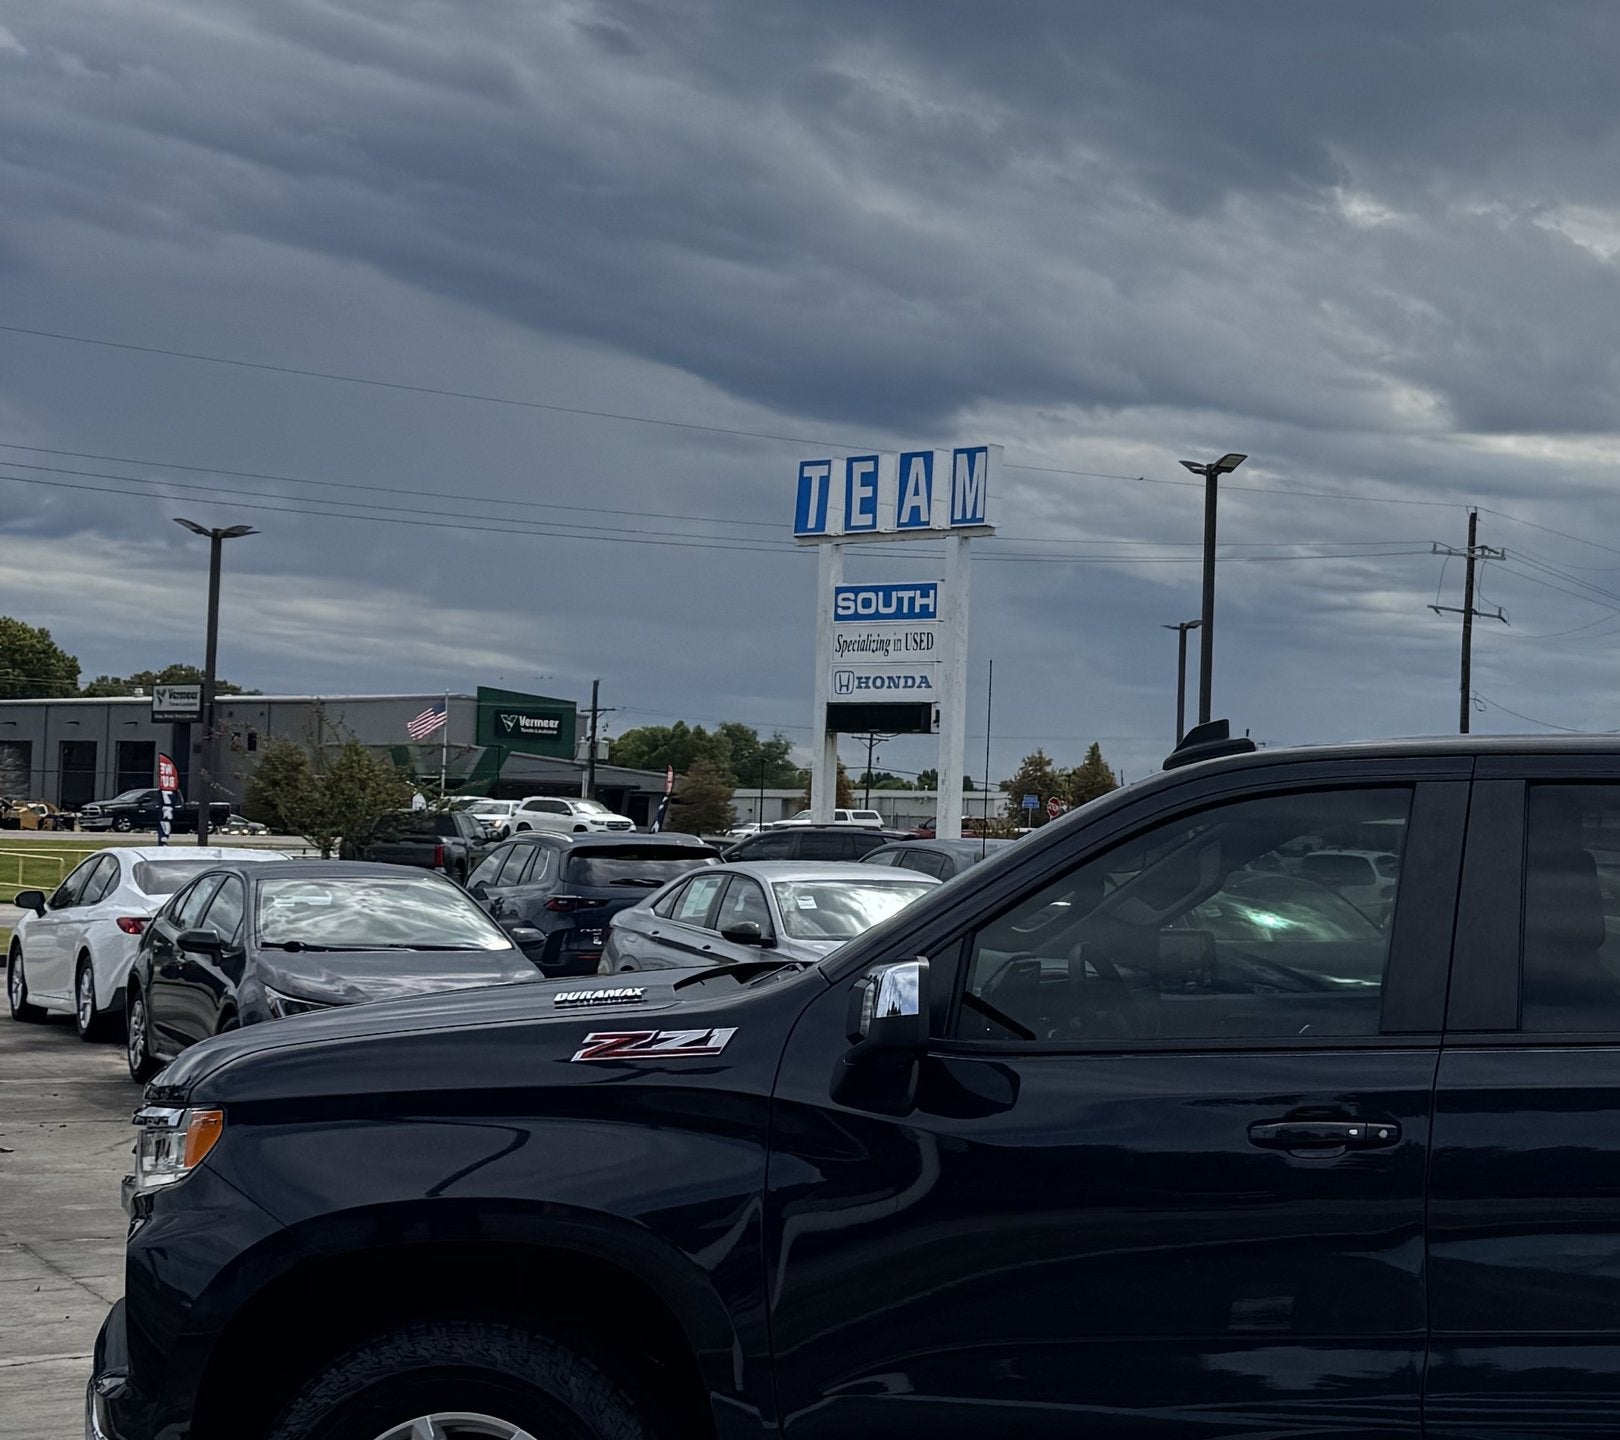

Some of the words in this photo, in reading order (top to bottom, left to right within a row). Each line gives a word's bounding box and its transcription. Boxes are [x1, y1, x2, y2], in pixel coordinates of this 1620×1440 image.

[803, 452, 986, 529] TEAM
[837, 590, 935, 615] SOUTH
[835, 633, 891, 657] Specializing
[893, 634, 902, 651] in
[905, 632, 934, 651] USED
[855, 675, 932, 690] HONDA
[519, 715, 559, 727] Vermeer
[554, 987, 646, 1002] DURAMAX
[570, 1027, 739, 1062] Z71
